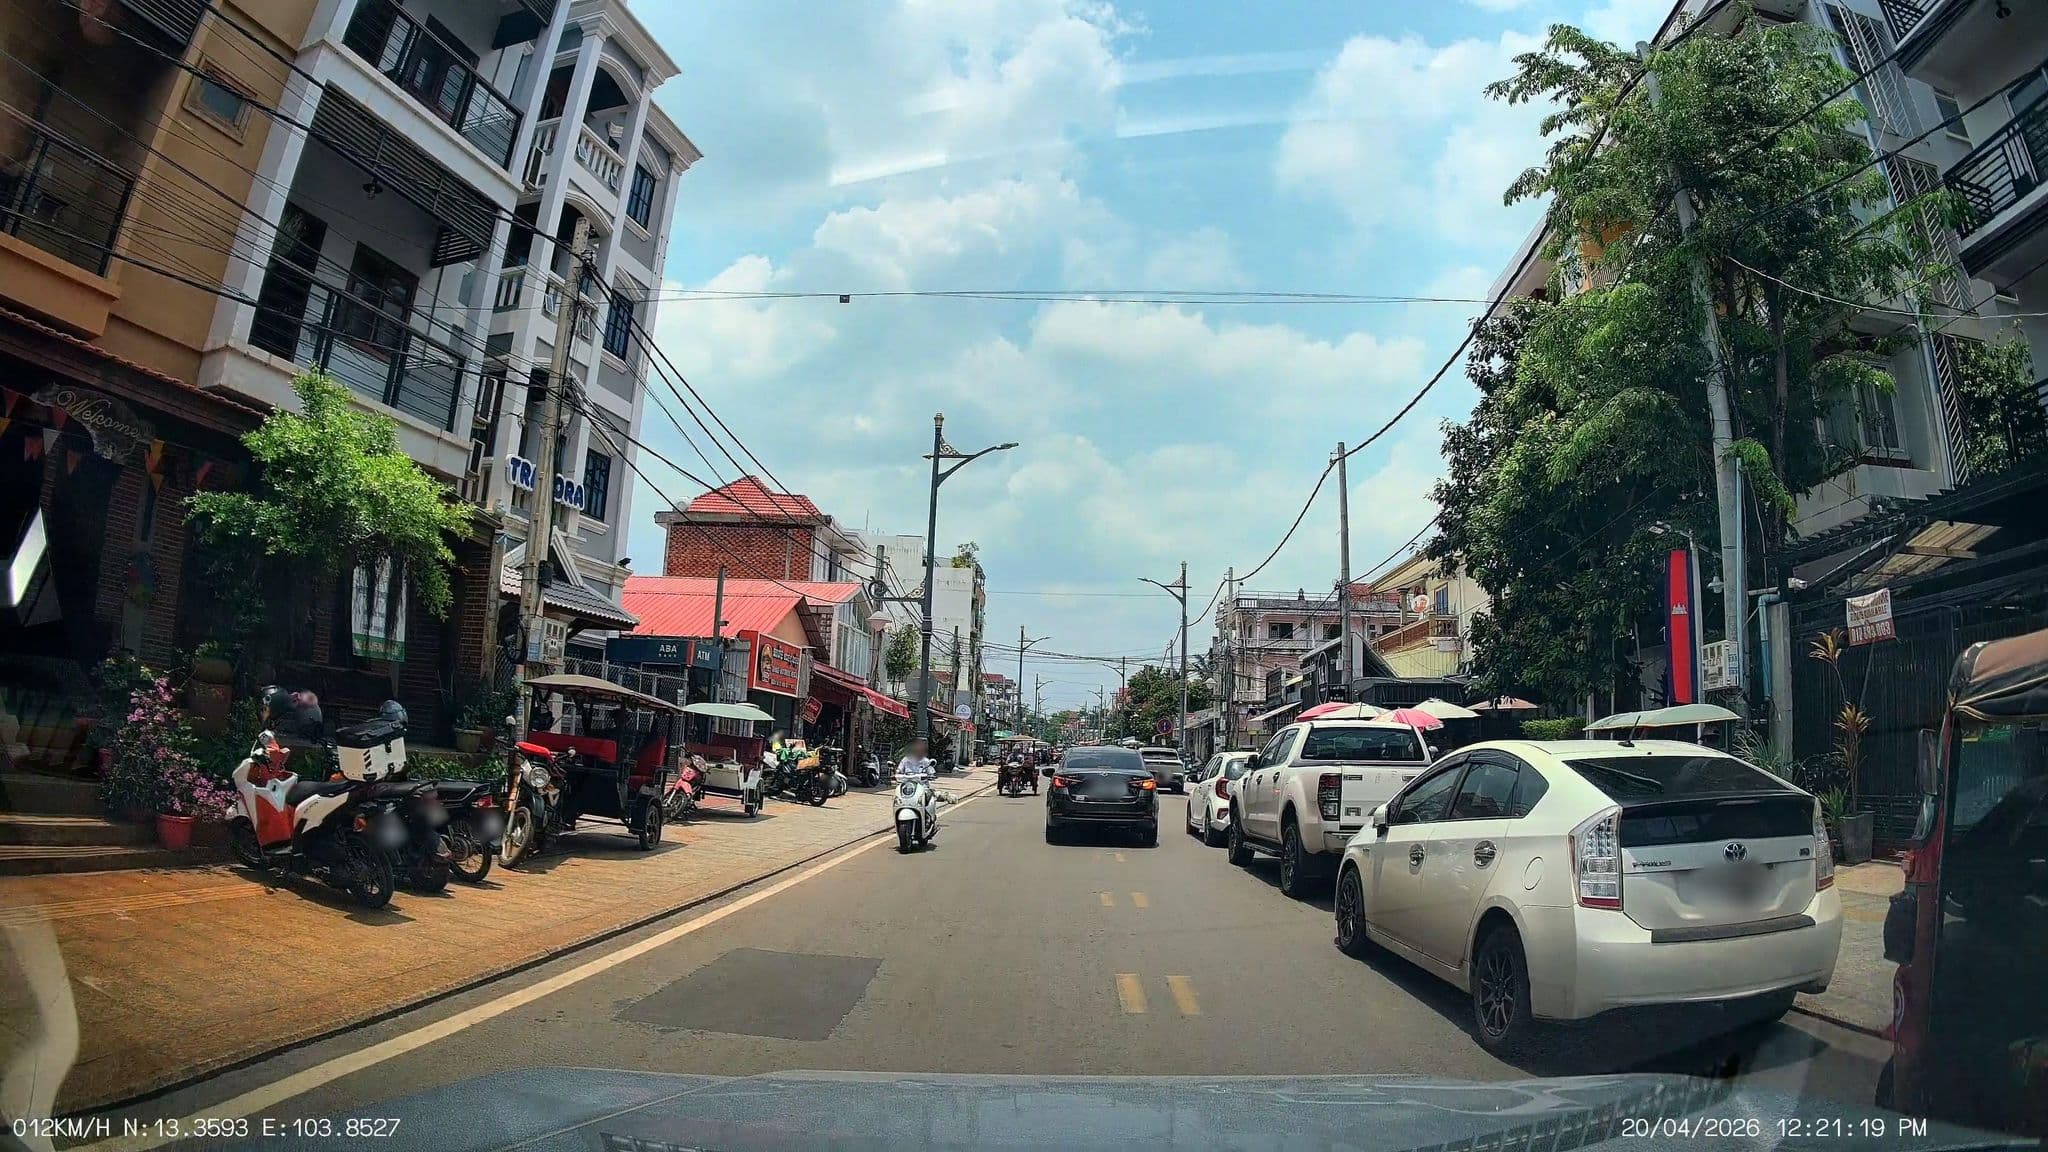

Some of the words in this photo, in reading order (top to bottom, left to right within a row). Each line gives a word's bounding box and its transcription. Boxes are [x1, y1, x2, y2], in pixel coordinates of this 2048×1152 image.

[56, 390, 141, 438] Welcome
[659, 644, 677, 653] ABA
[697, 650, 710, 661] ATM
